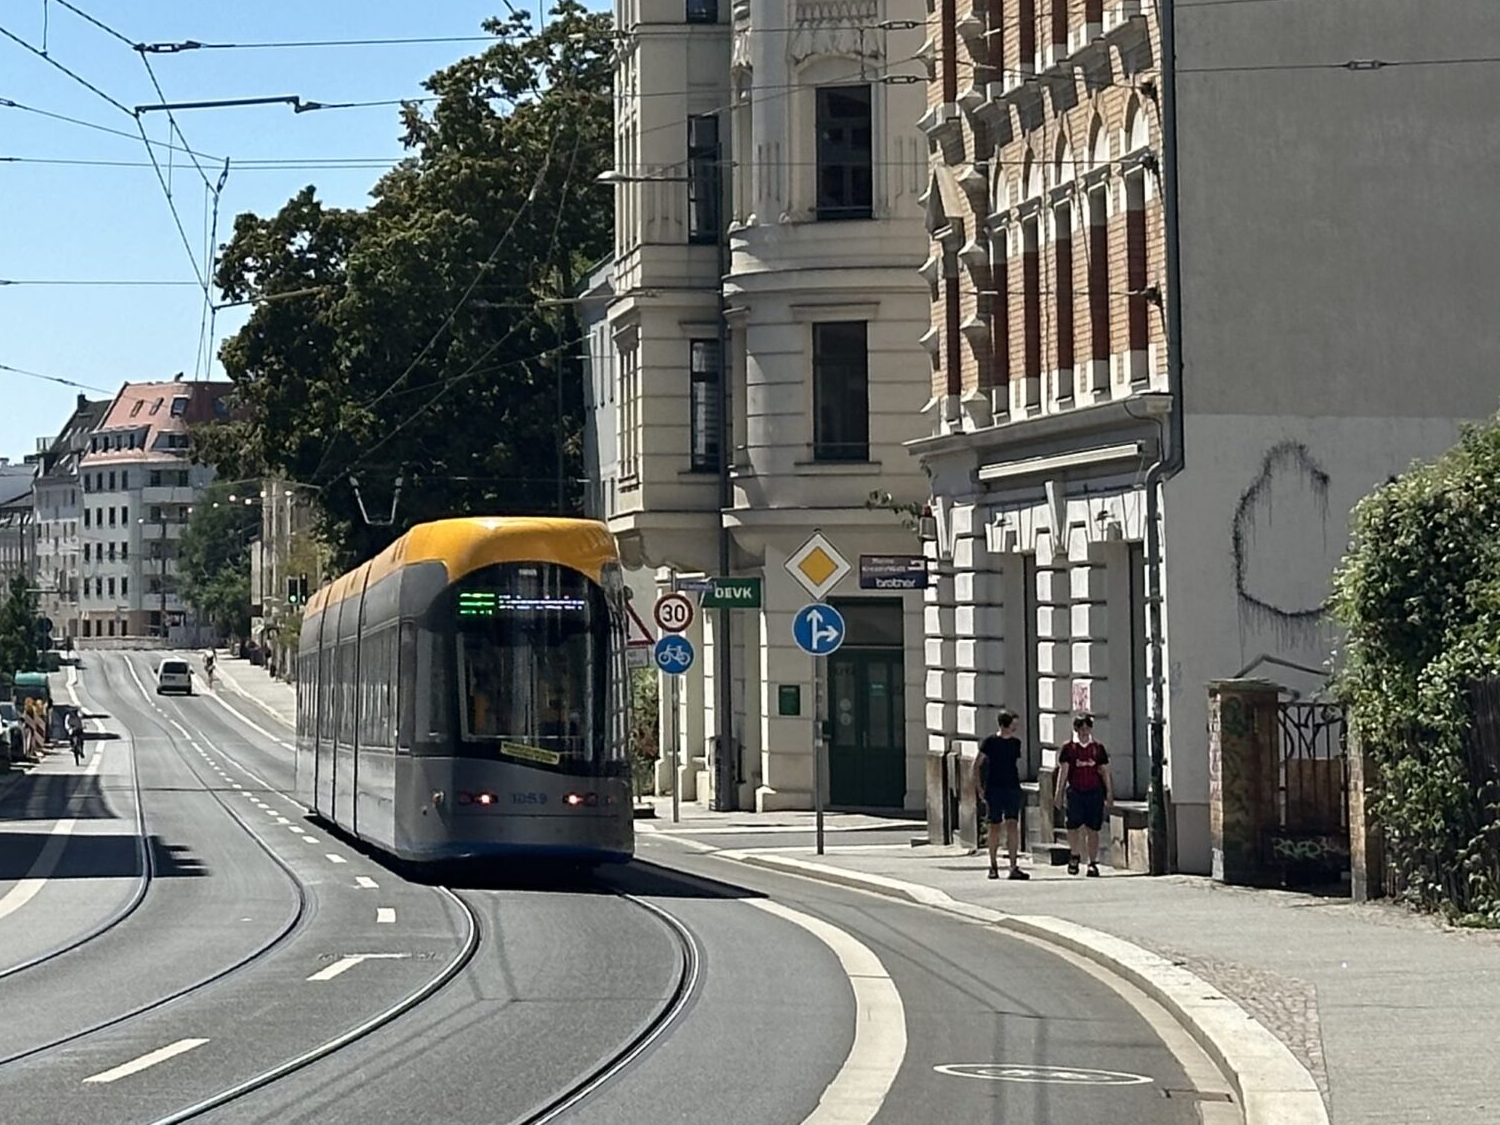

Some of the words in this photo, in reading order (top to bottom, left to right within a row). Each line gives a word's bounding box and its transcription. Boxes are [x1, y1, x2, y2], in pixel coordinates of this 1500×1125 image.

[876, 578, 916, 588] brother
[715, 586, 753, 599] DEVK
[662, 604, 686, 623] 30
